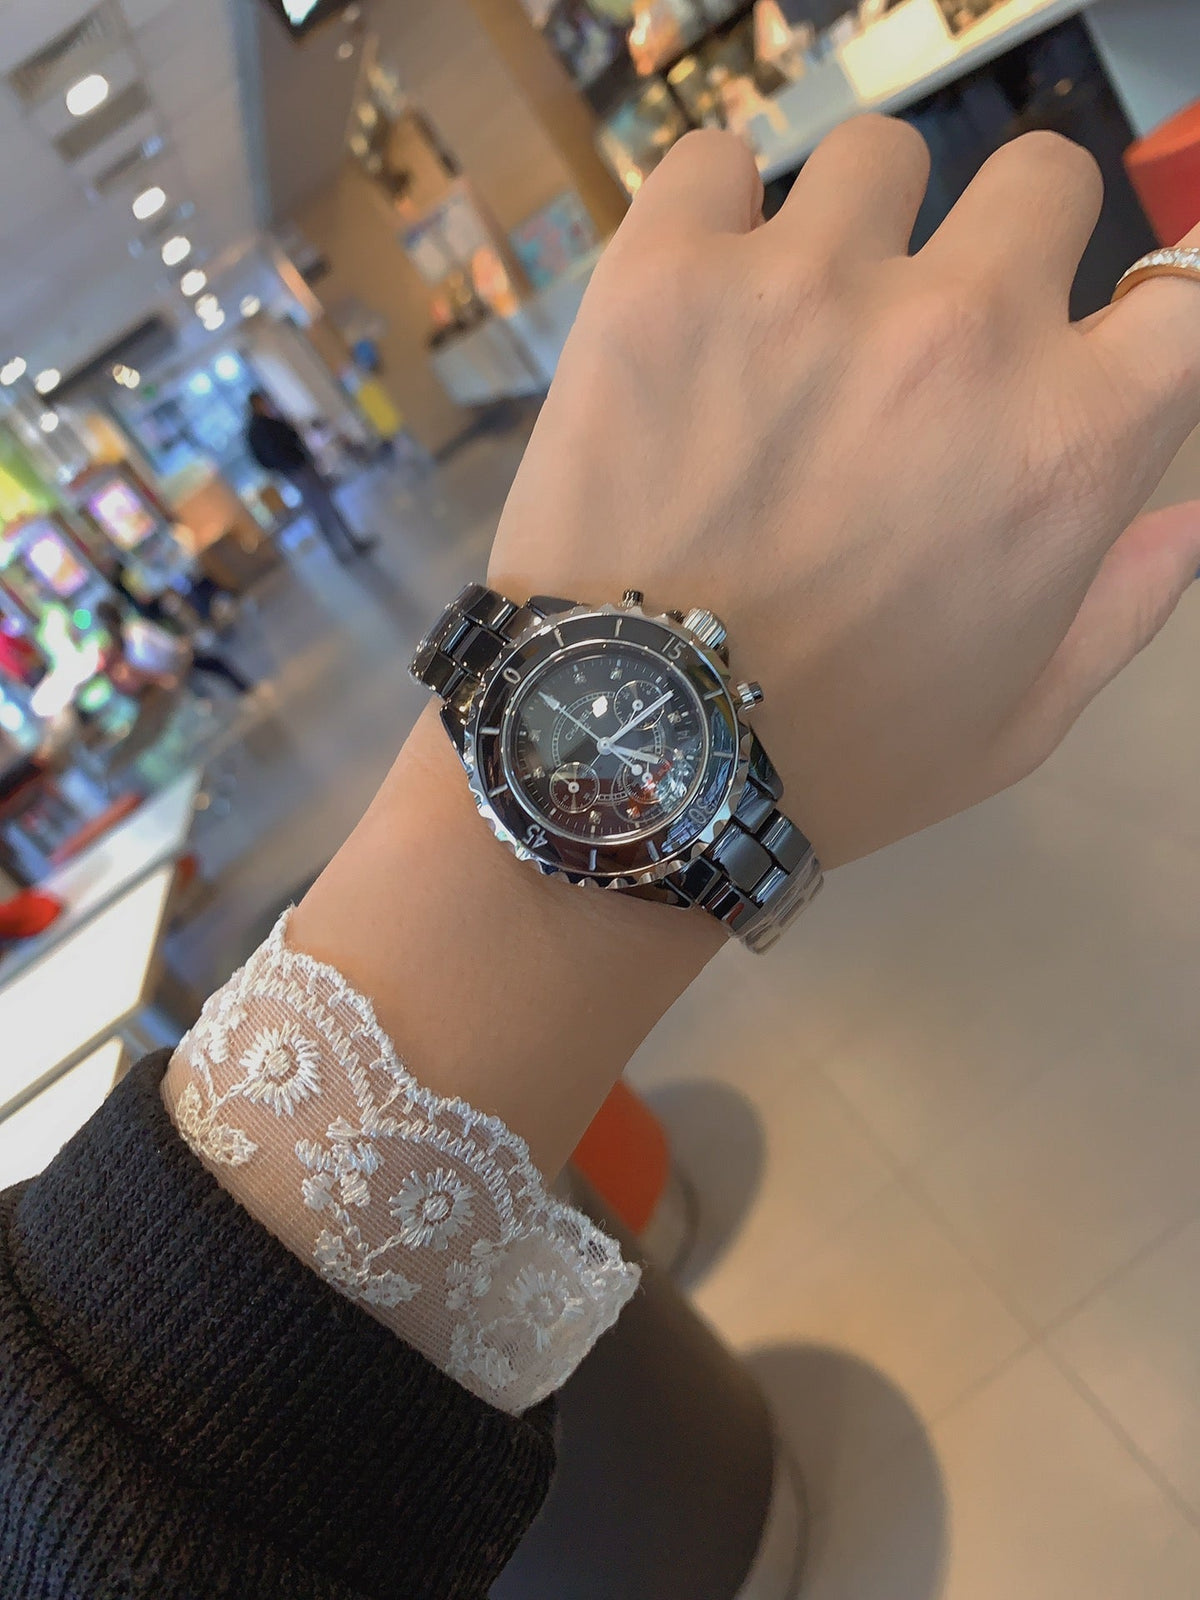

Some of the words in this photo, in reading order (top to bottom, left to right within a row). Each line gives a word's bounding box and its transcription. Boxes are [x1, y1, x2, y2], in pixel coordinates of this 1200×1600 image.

[662, 636, 687, 660] 15
[502, 667, 521, 685] 0
[689, 797, 717, 824] 30
[523, 824, 548, 848] 45
